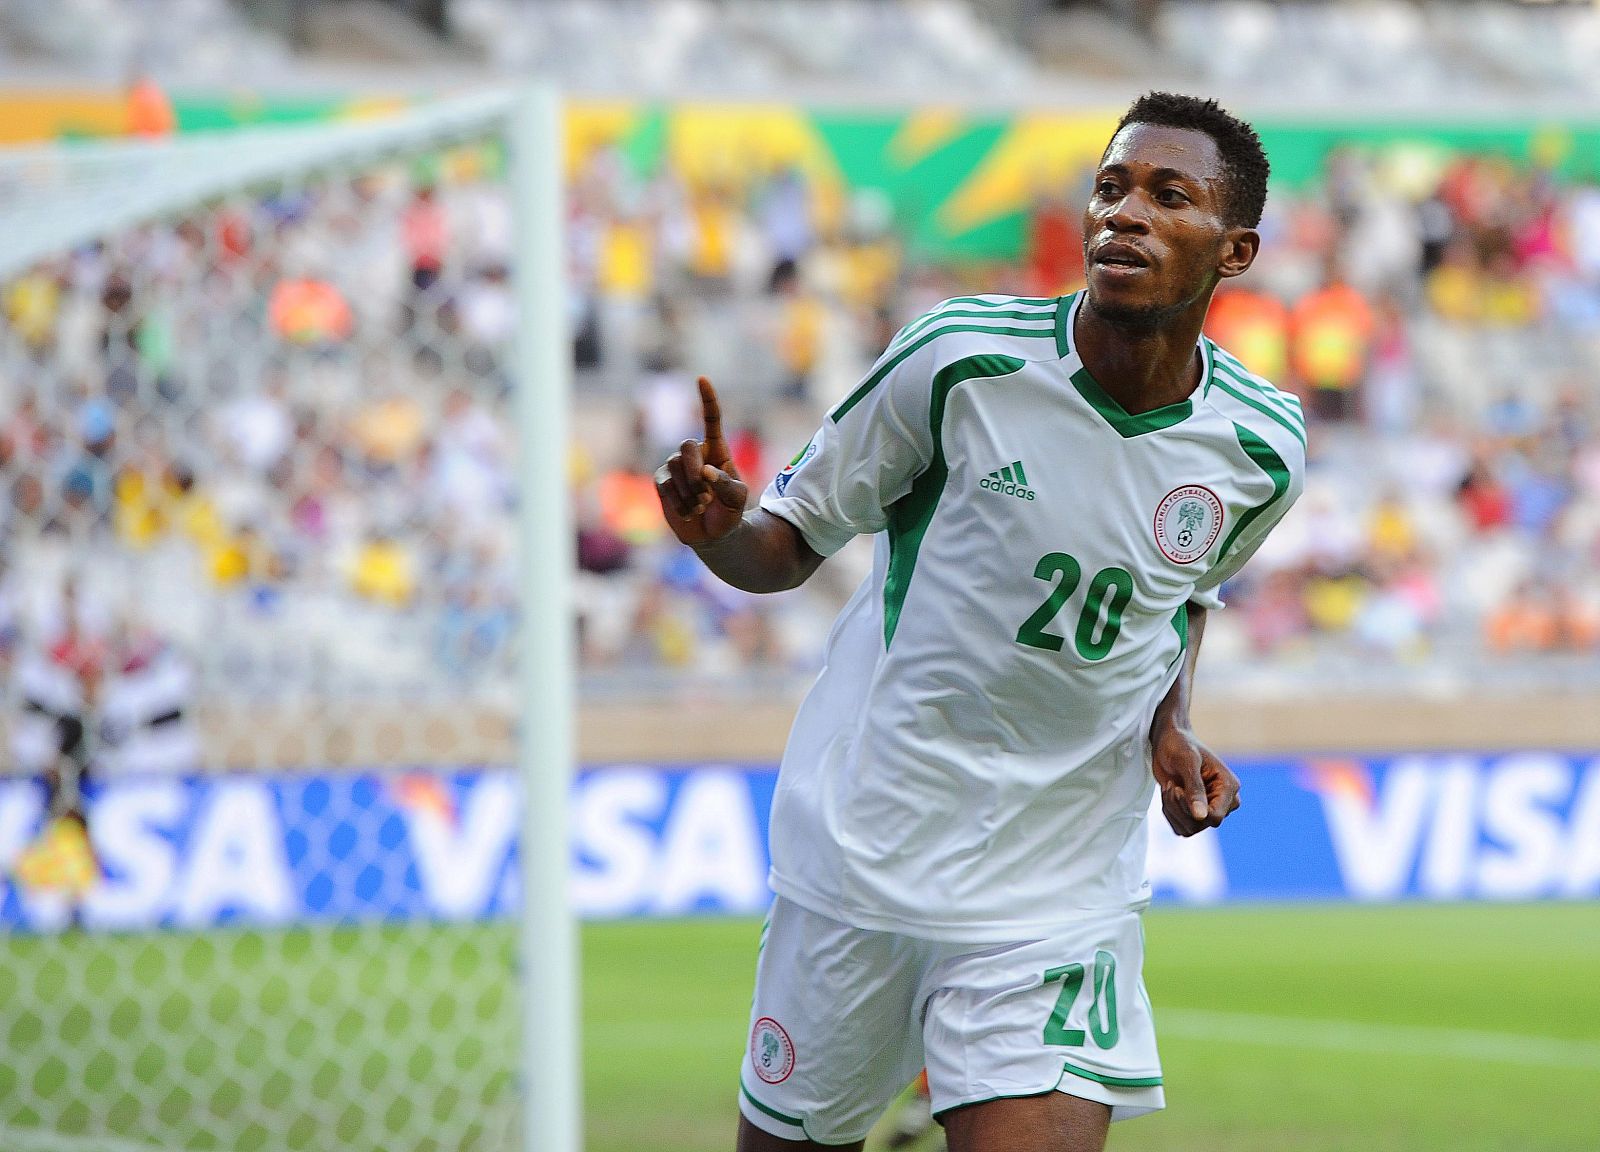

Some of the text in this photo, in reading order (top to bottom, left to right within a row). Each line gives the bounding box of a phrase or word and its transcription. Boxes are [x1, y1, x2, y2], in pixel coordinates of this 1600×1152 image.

[979, 477, 1036, 501] adidas
[1157, 489, 1220, 546] NIGERIA FOOTBALL FEDERATION
[1170, 550, 1193, 560] ABUJA
[1016, 552, 1133, 661] 20
[397, 768, 768, 914] VSA
[1043, 950, 1119, 1050] 20
